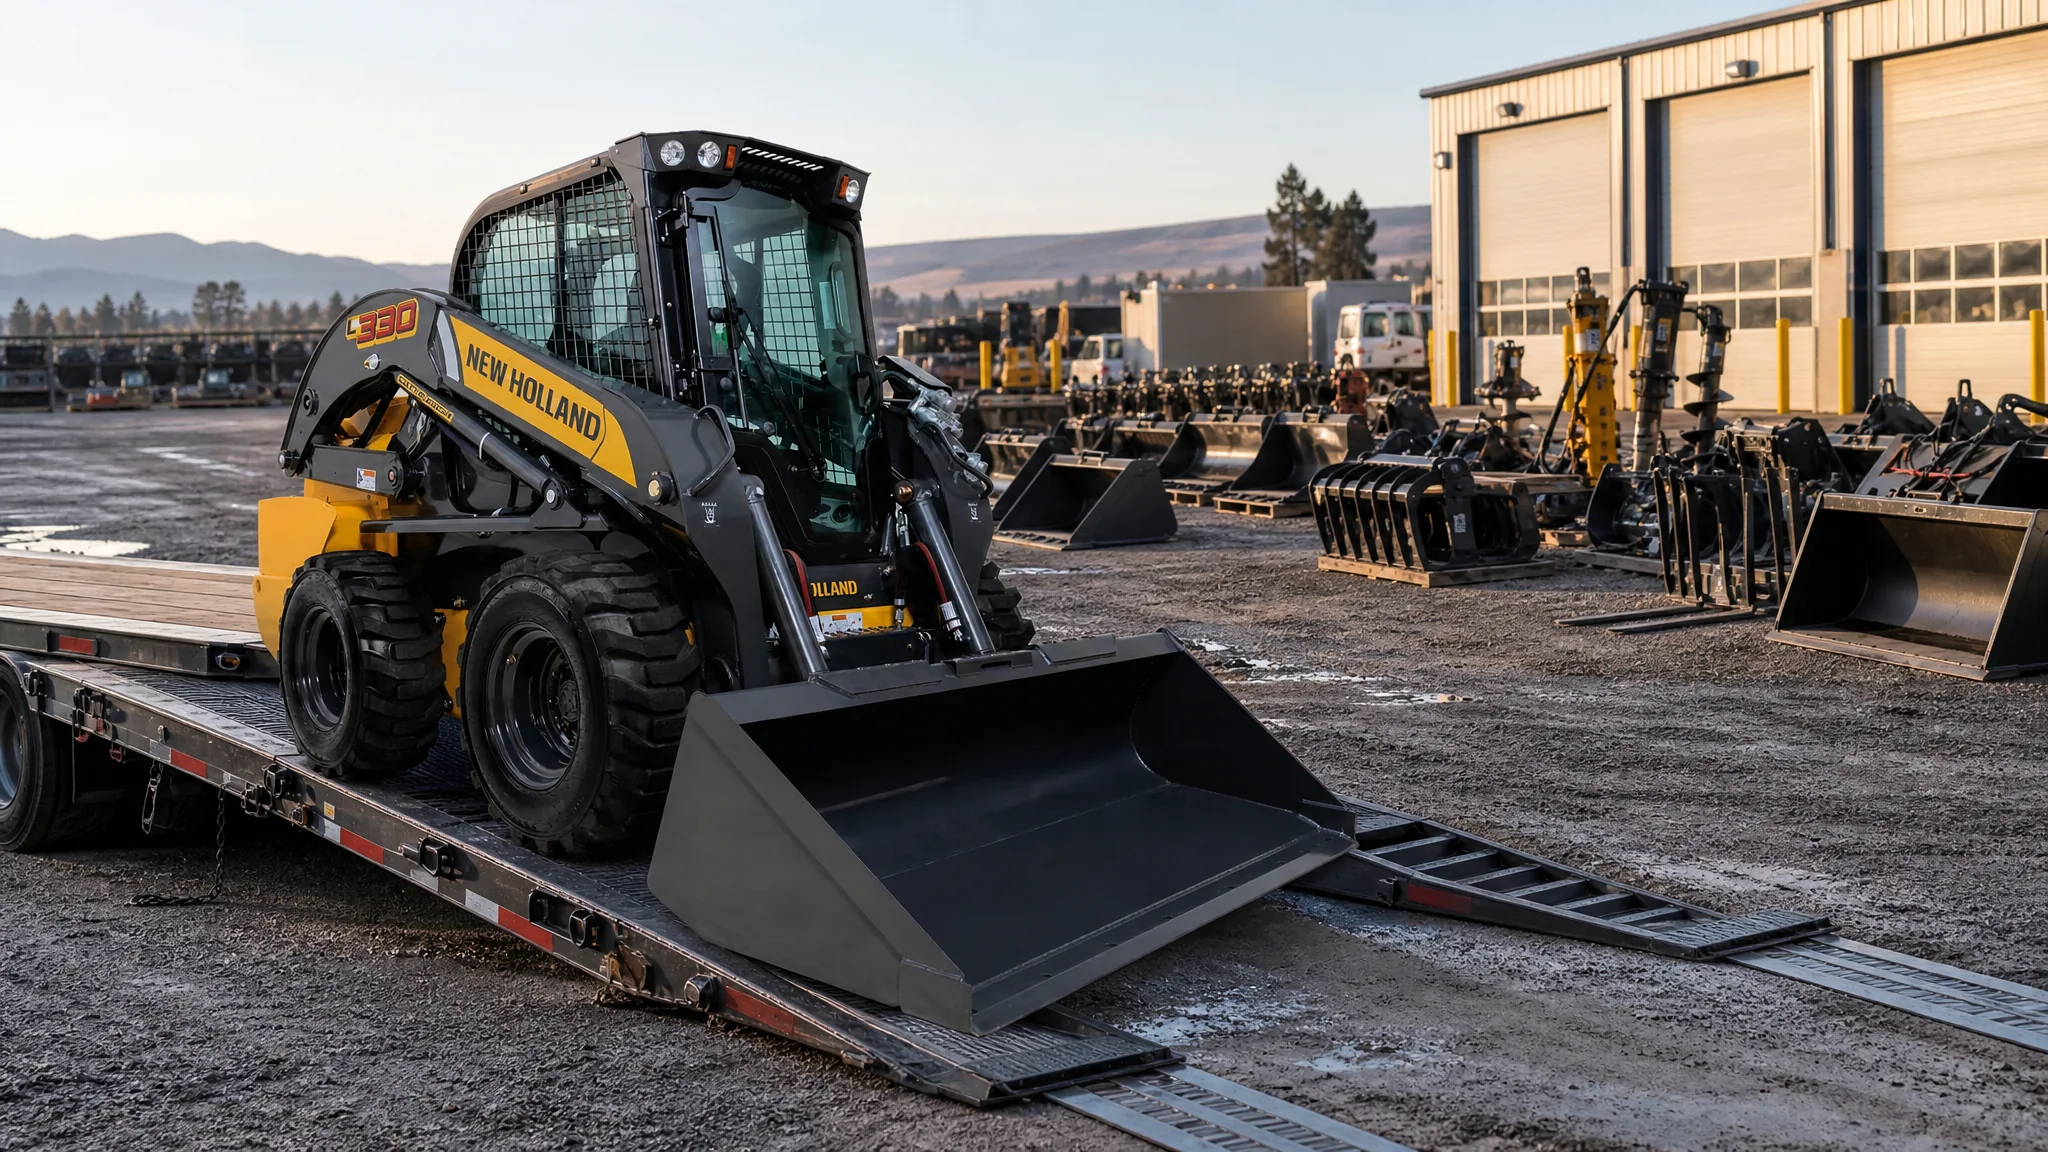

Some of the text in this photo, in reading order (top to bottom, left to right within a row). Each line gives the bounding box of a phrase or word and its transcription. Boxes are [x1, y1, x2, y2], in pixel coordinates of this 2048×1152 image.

[346, 299, 418, 347] L330
[466, 343, 508, 387] NEW
[509, 367, 601, 442] HOLLAND
